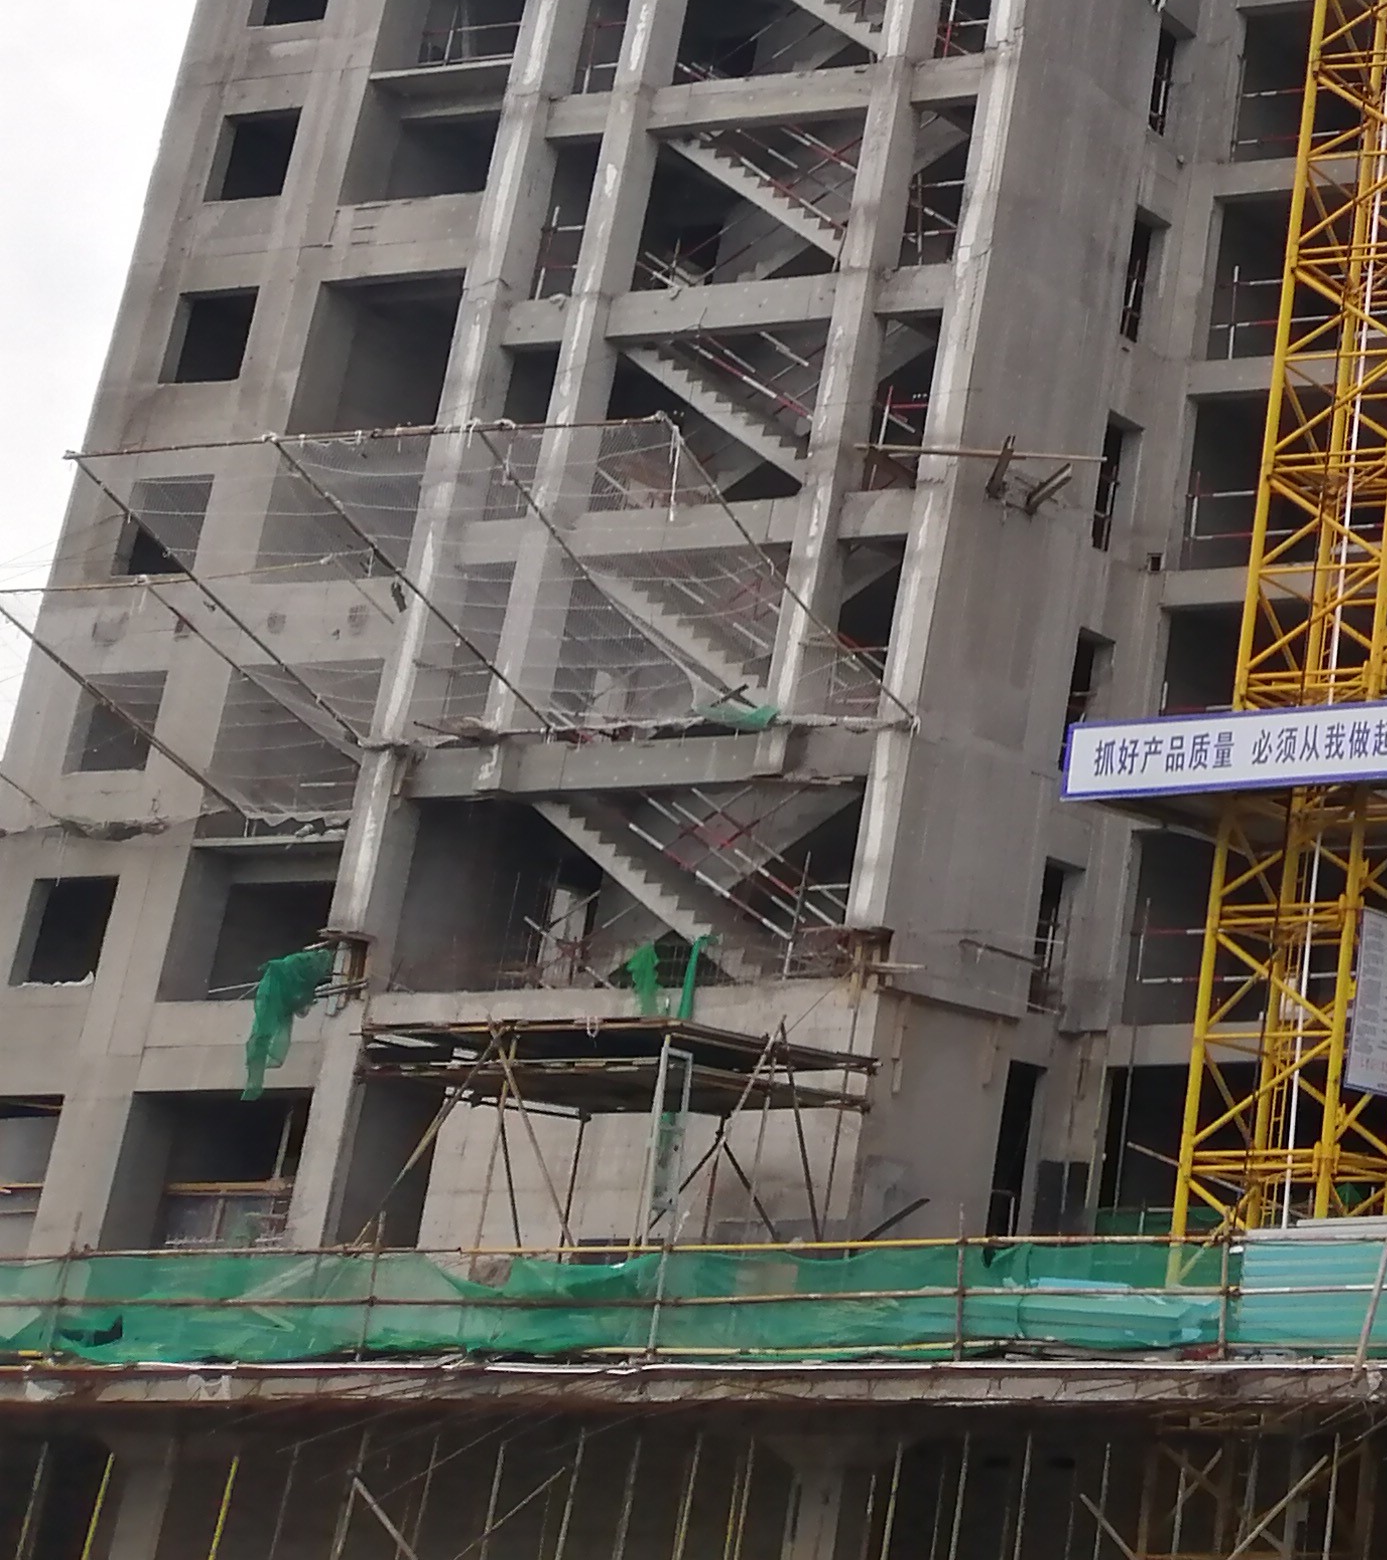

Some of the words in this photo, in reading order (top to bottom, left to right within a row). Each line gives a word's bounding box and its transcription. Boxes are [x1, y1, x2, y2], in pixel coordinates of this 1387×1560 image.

[1093, 731, 1234, 777] 抓好产品质量
